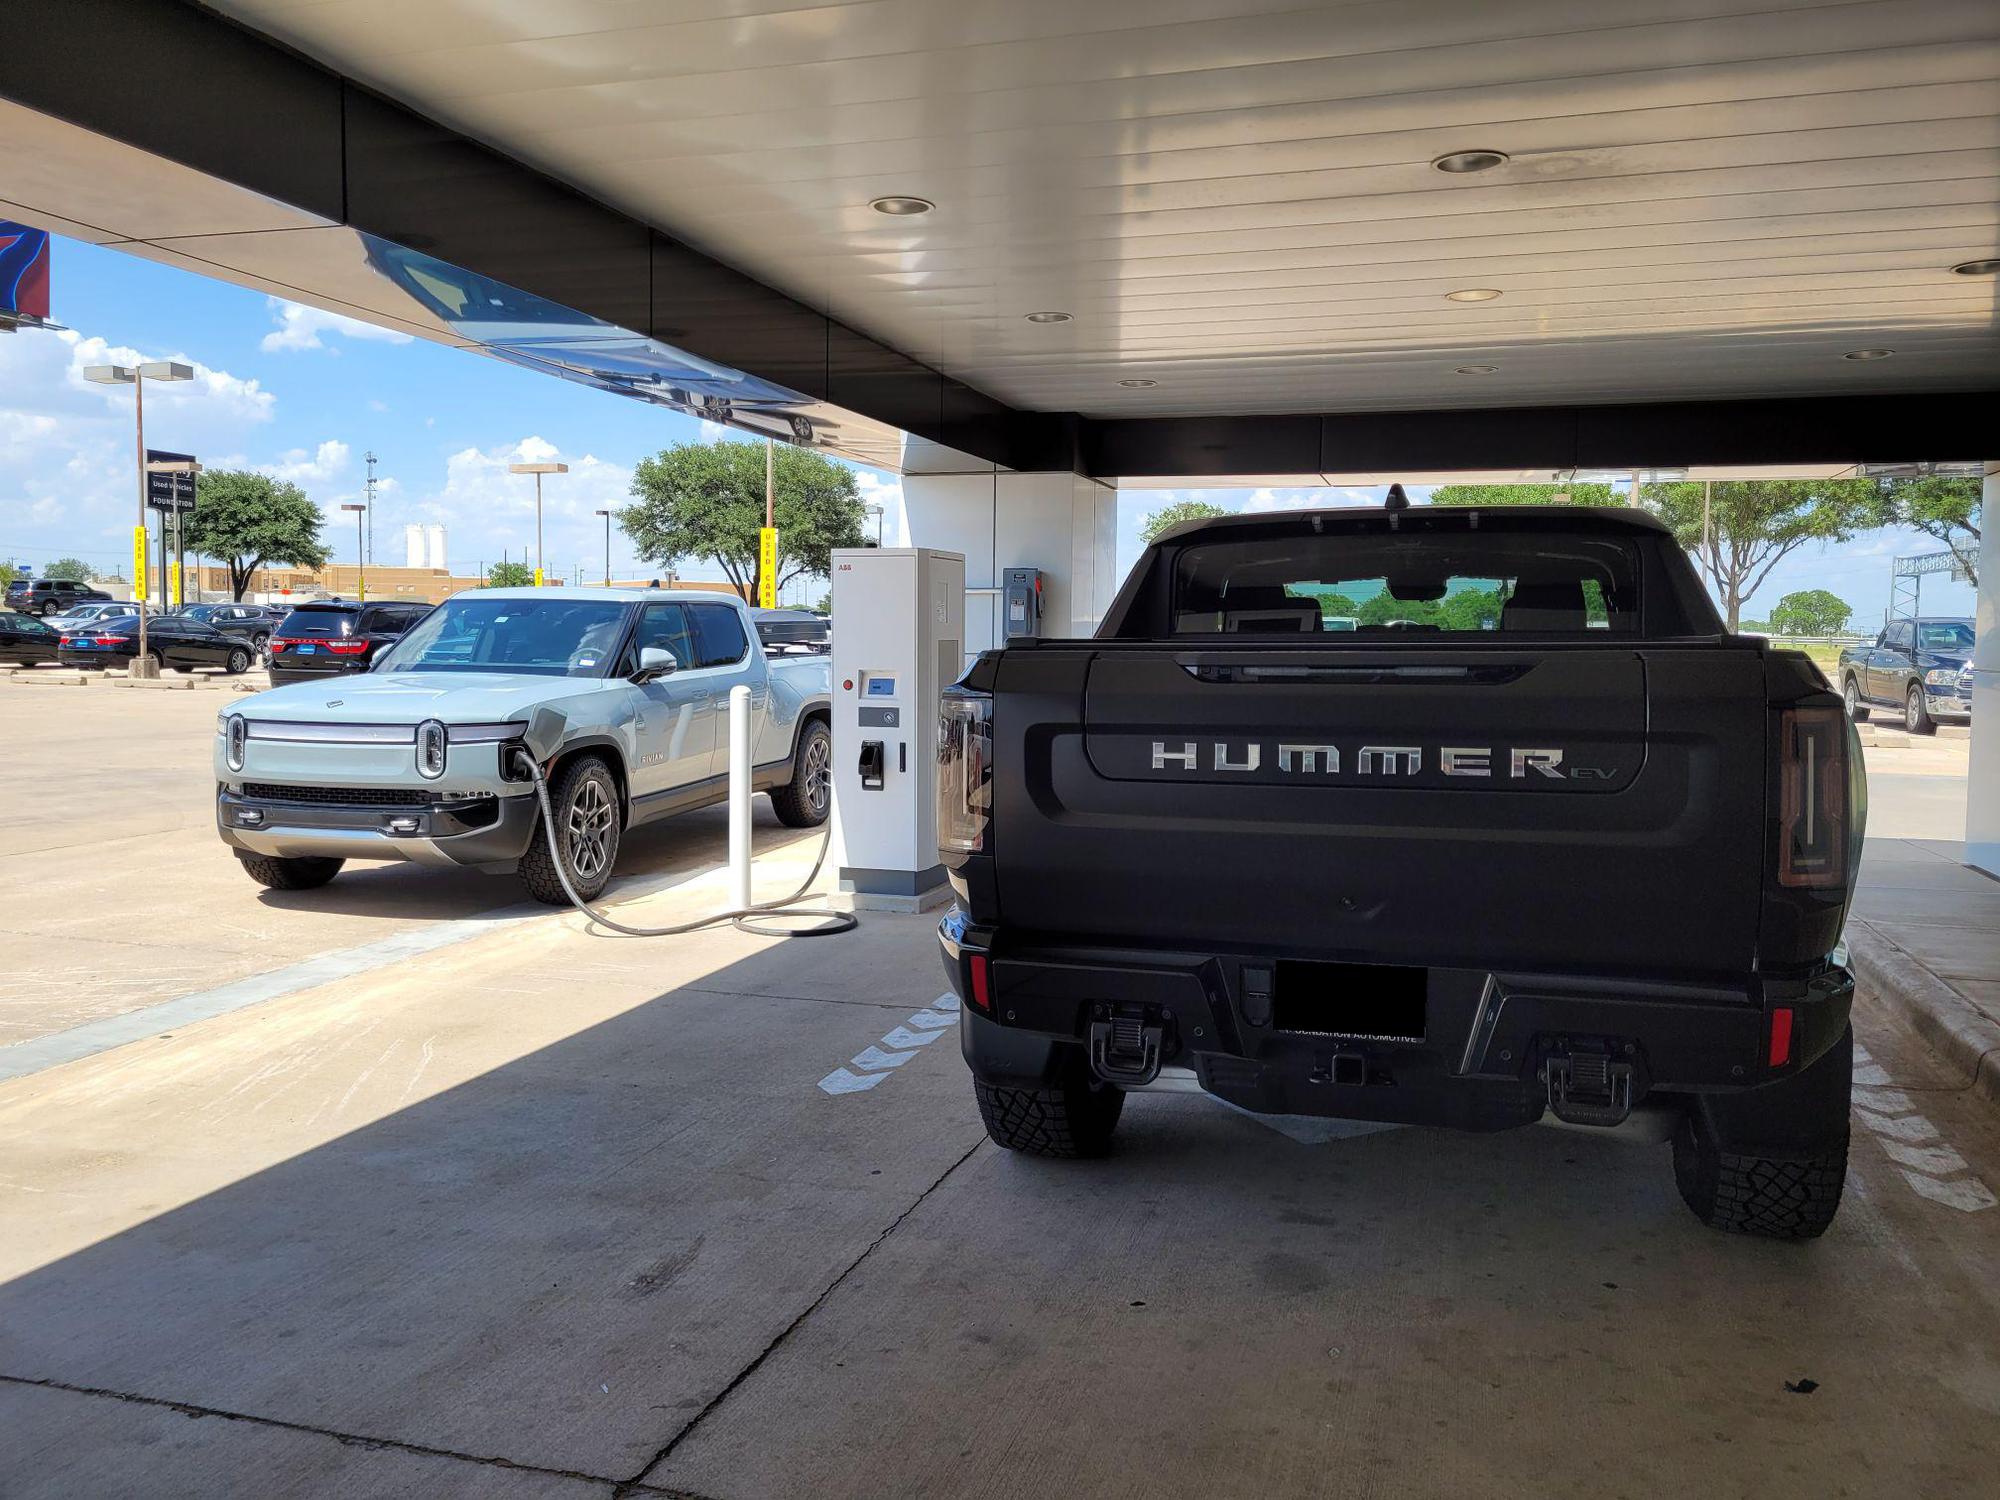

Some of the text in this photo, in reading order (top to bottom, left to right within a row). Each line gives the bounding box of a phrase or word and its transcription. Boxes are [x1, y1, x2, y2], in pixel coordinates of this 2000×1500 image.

[153, 480, 192, 491] Used Vhicles
[641, 752, 664, 763] RIVIAN
[1151, 742, 1618, 779] HUMMER EV
